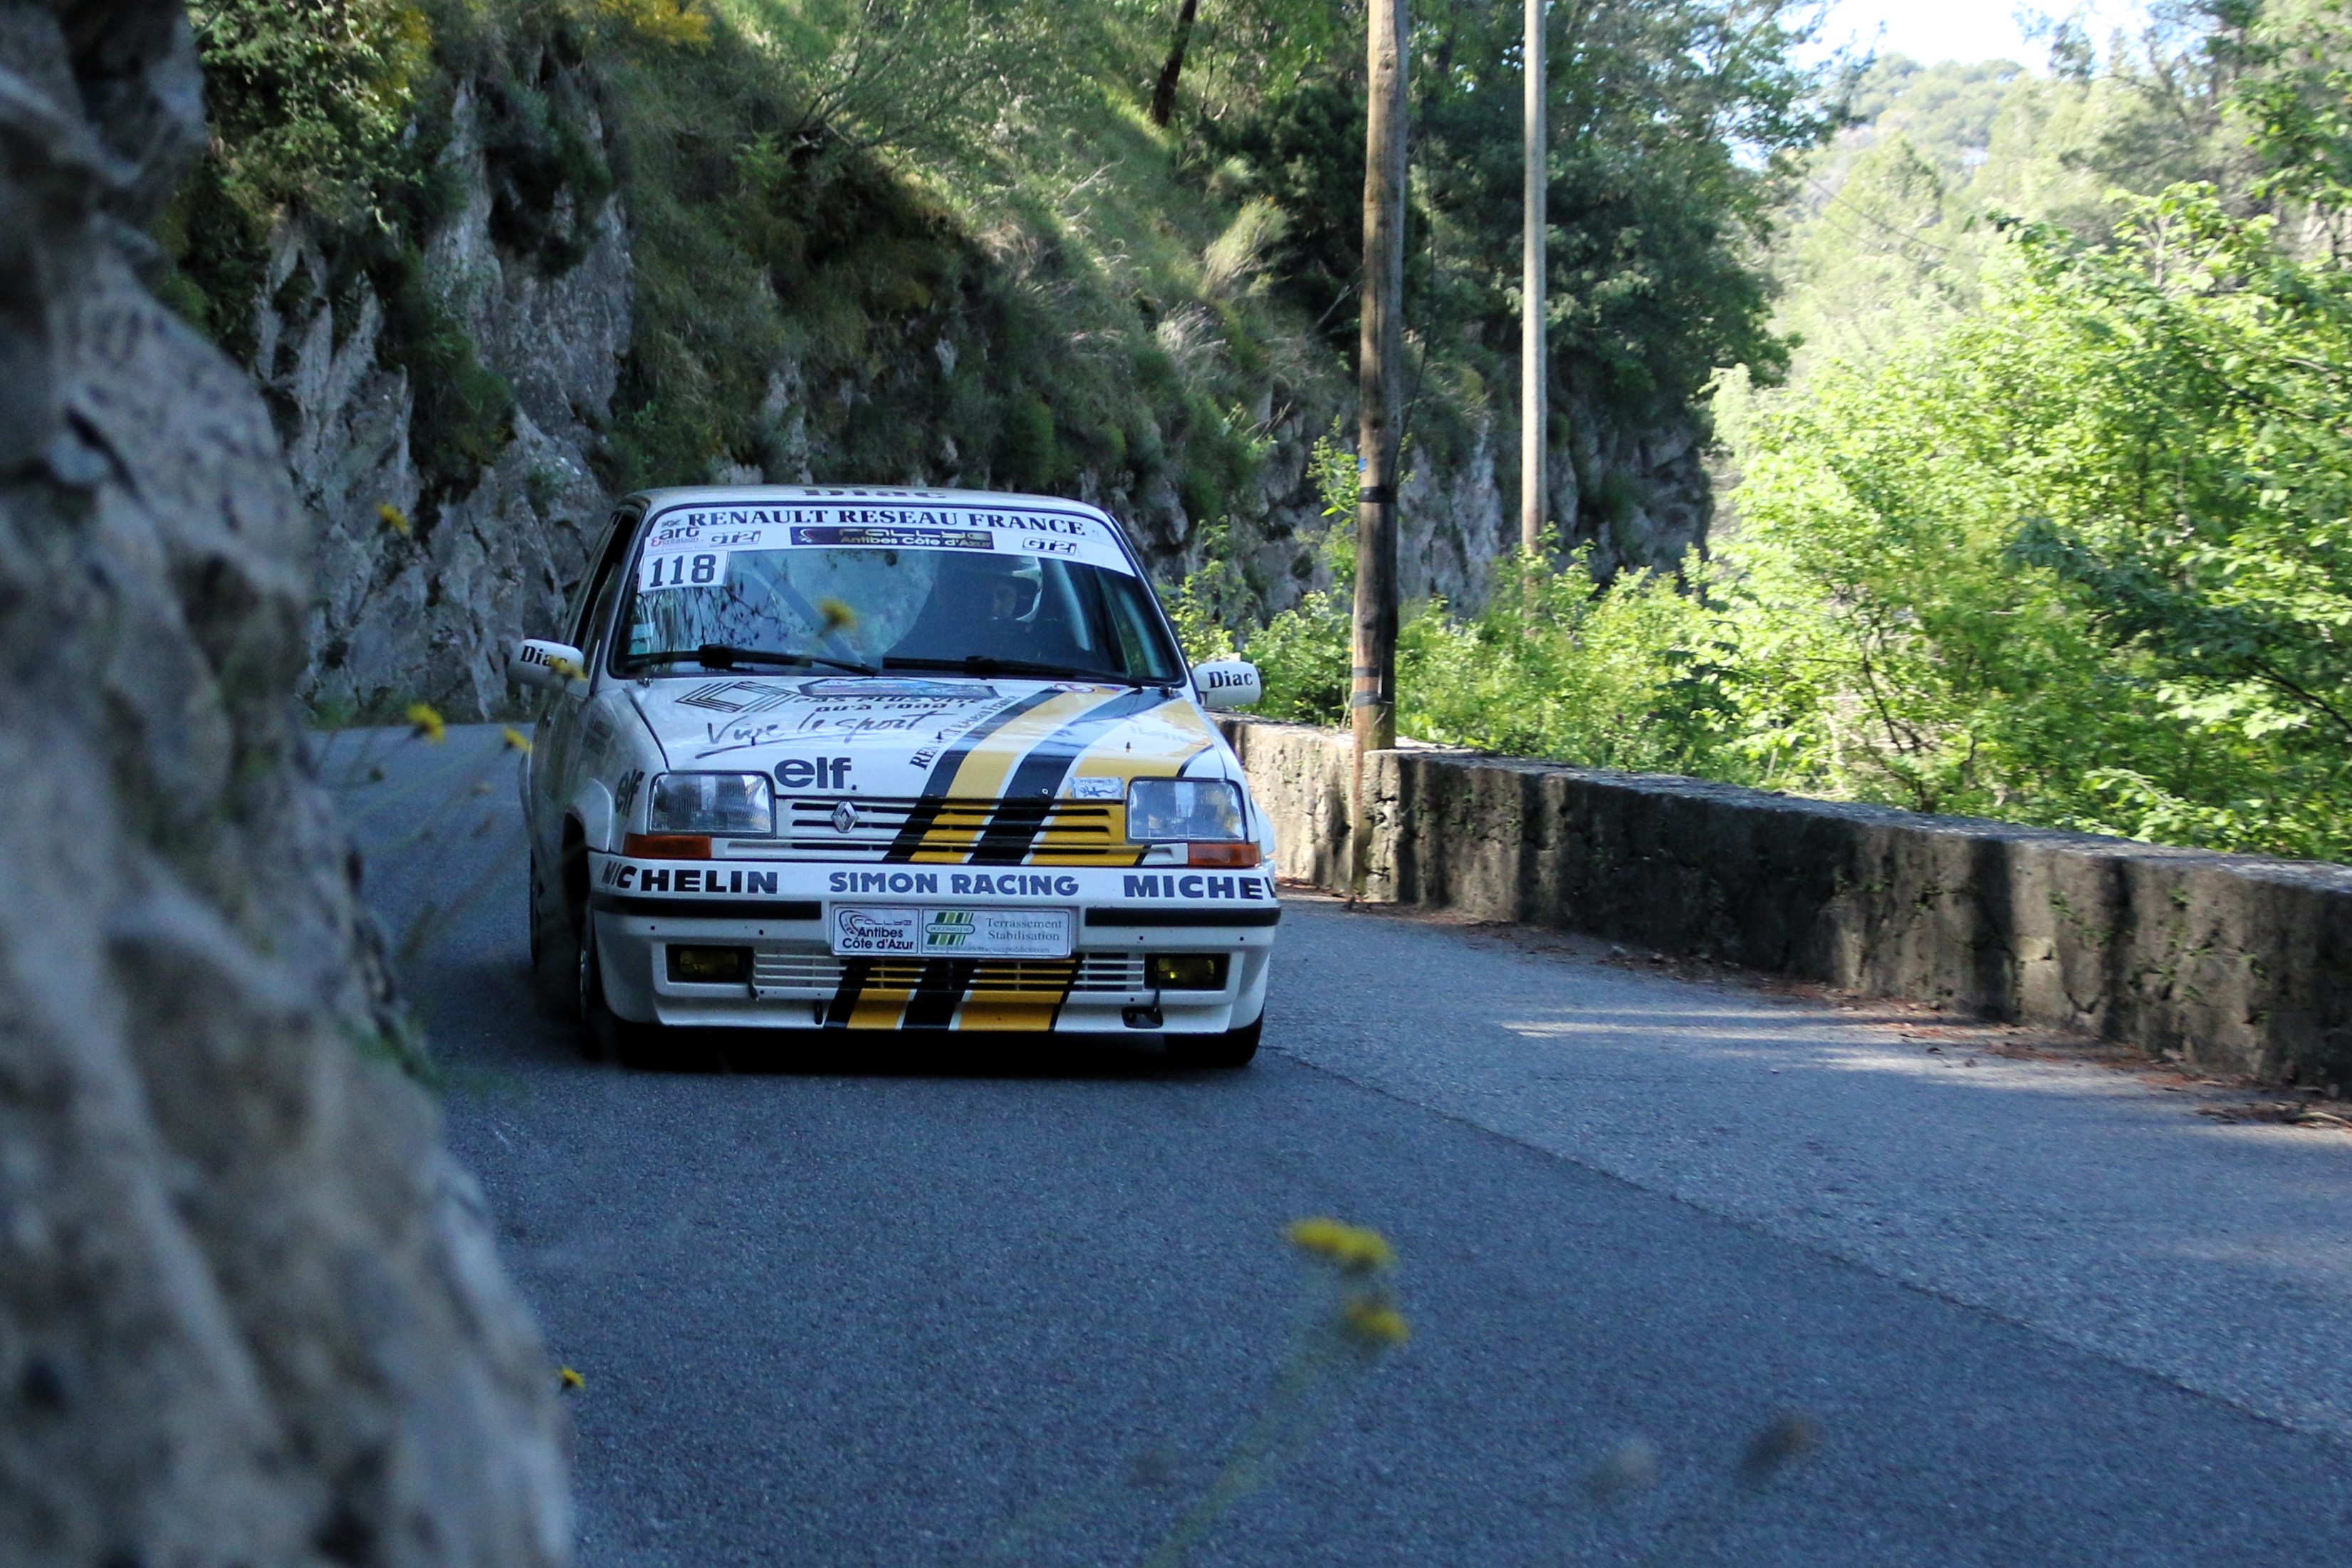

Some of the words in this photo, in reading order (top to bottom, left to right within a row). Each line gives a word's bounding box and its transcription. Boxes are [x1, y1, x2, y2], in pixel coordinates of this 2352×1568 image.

[688, 510, 827, 526] RENAULT
[837, 510, 958, 526] RESEAU
[968, 513, 1086, 535] FRANCE
[841, 535, 897, 545] Antibes
[902, 537, 938, 546] Côte
[944, 538, 991, 548] d'Azur
[649, 554, 716, 587] 118
[520, 645, 568, 667] Dia
[1208, 671, 1253, 689] Diac
[708, 715, 783, 744] Vive
[774, 757, 852, 790] elf
[829, 872, 937, 895] SIMON
[951, 873, 1080, 897] RACING
[857, 926, 904, 939] Antibes
[986, 918, 1062, 929] Terrassement
[842, 937, 872, 949] Côte
[877, 939, 914, 950] d'Azur
[988, 931, 1060, 941] Stabilisation
